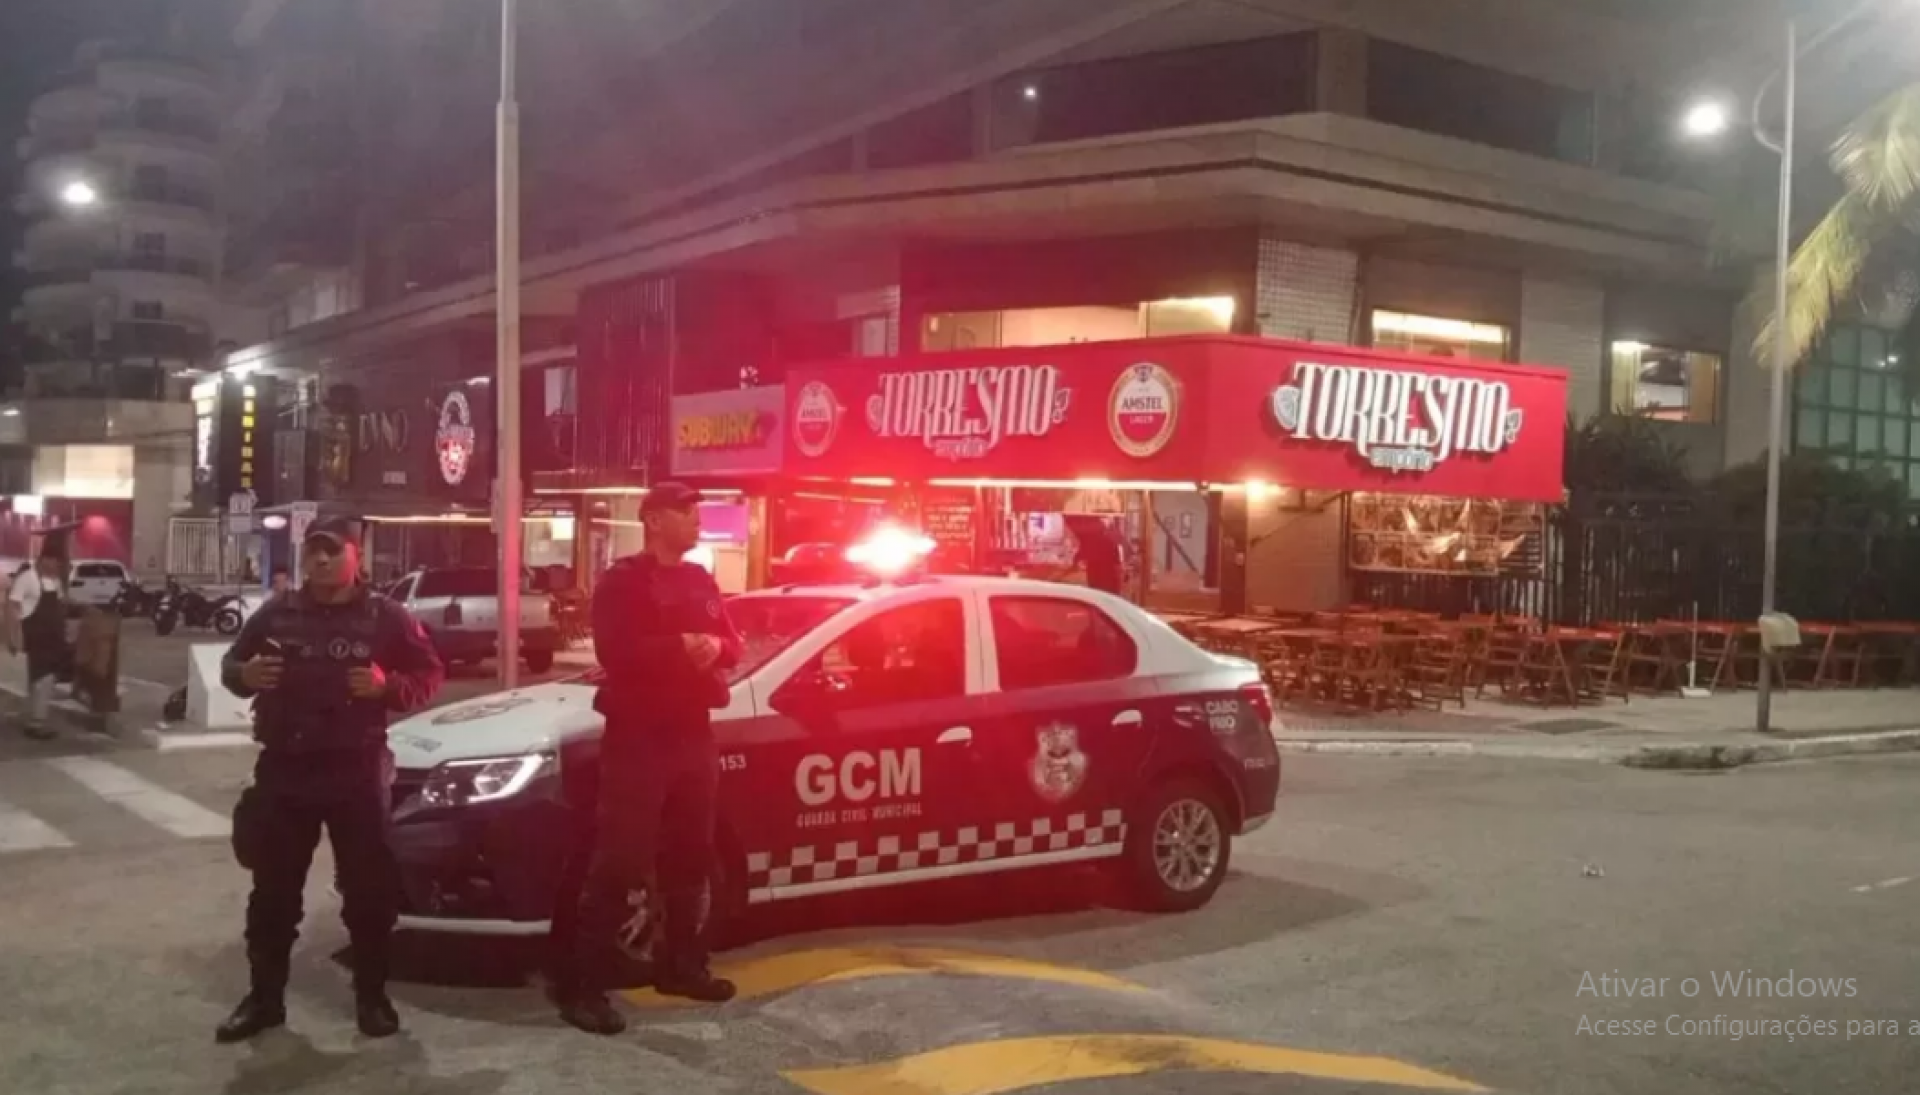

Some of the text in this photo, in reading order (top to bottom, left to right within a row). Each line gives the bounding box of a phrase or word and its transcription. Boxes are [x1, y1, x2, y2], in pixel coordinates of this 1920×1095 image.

[878, 365, 1057, 449] TORRESMO
[1121, 396, 1163, 410] AMSTEL
[1293, 361, 1510, 462] TORRESMO
[679, 410, 759, 449] SUBWAY
[1204, 699, 1239, 714] CABO
[719, 753, 747, 771] 153
[795, 747, 922, 806] GCM
[796, 802, 922, 828] GUARDA CIVIL MUNICIPAL
